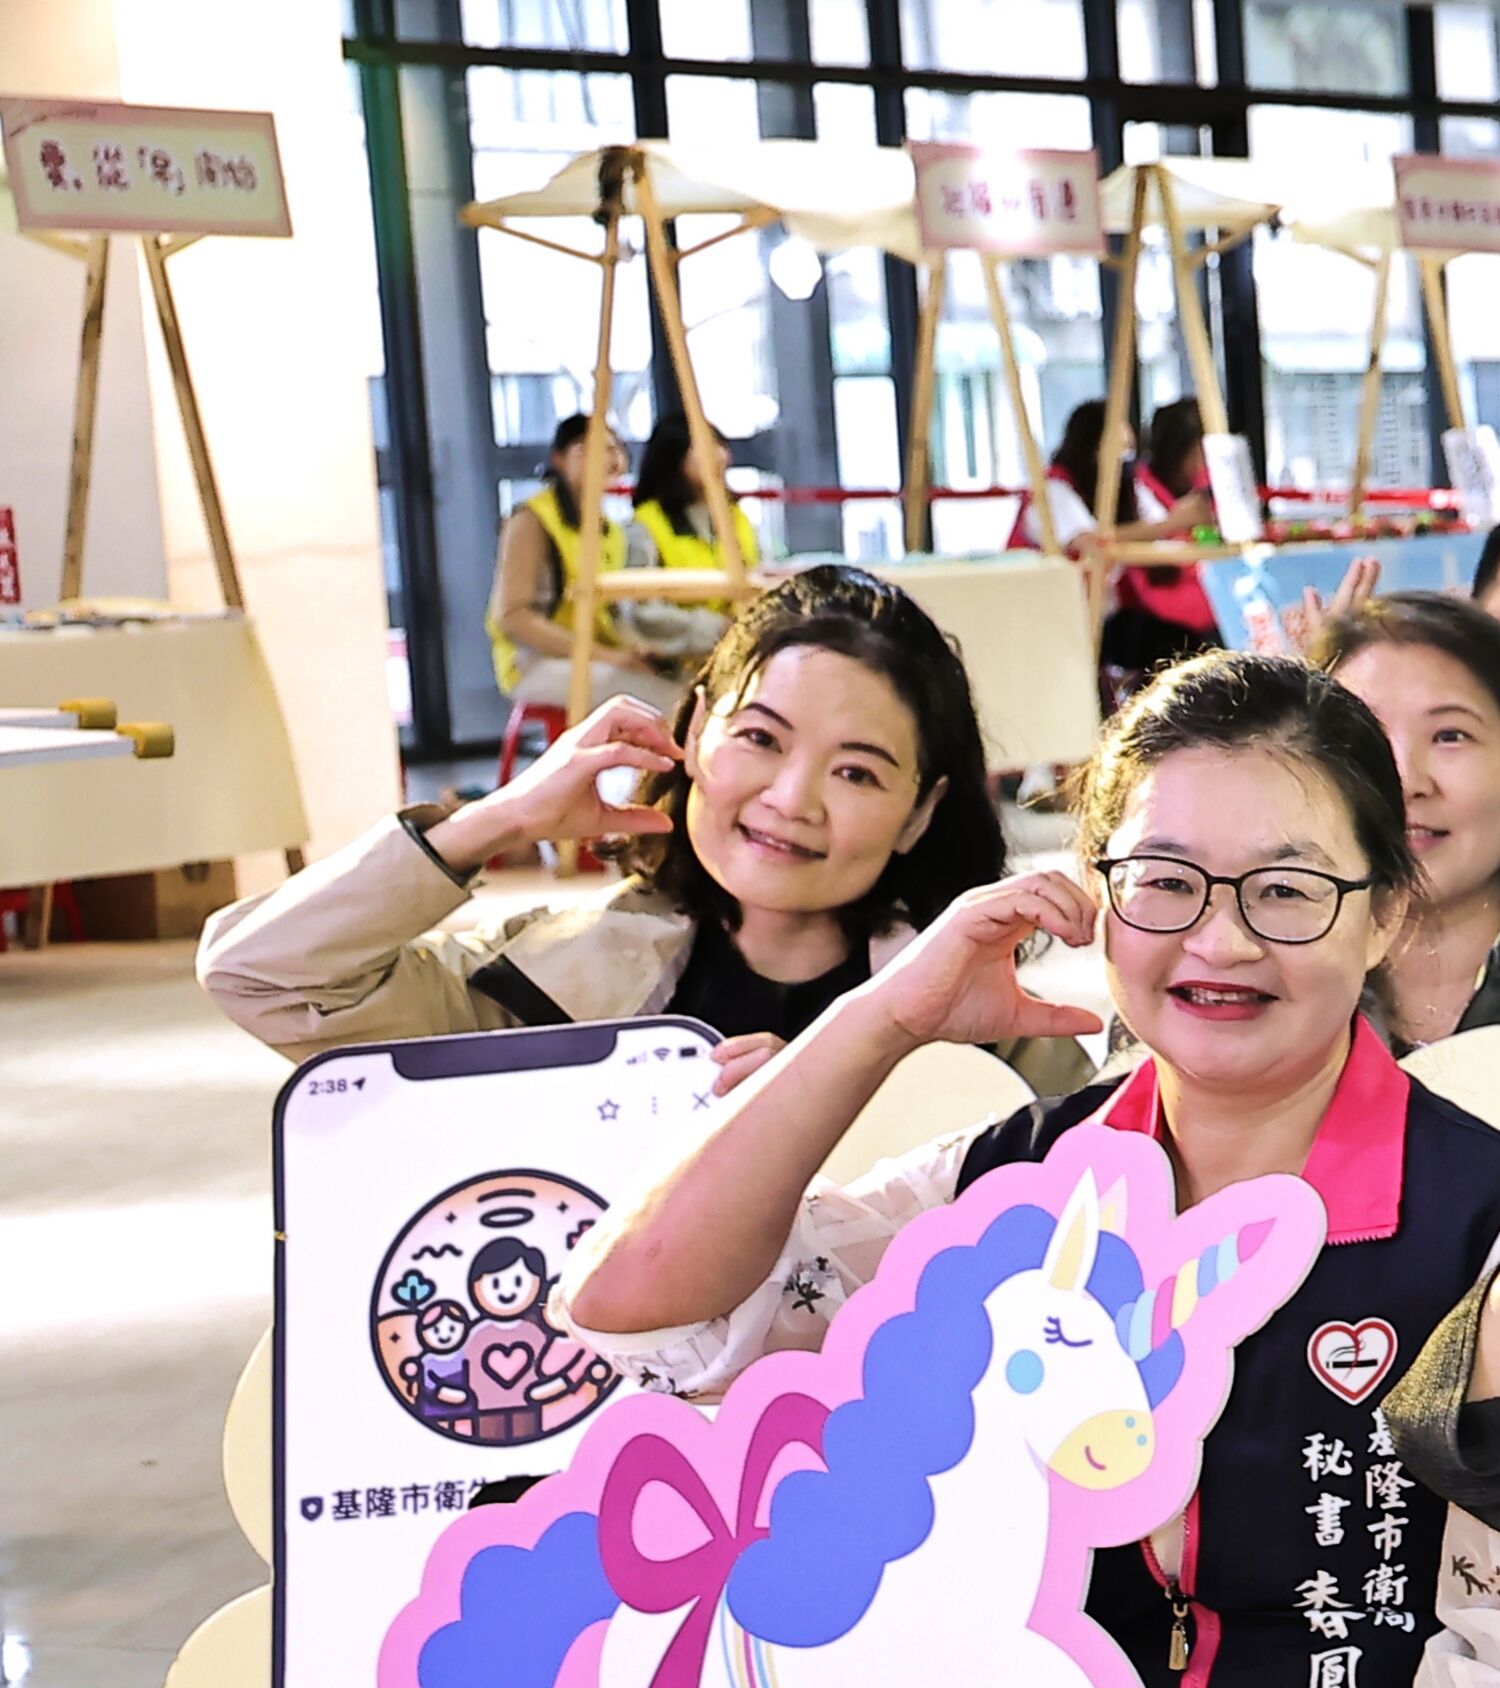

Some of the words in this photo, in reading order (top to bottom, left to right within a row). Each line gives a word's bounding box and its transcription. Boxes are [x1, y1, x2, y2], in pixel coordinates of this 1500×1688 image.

[309, 1079, 347, 1095] 2:38
[331, 1476, 488, 1522] 基隆市衛
[1302, 1431, 1353, 1547] 秘書
